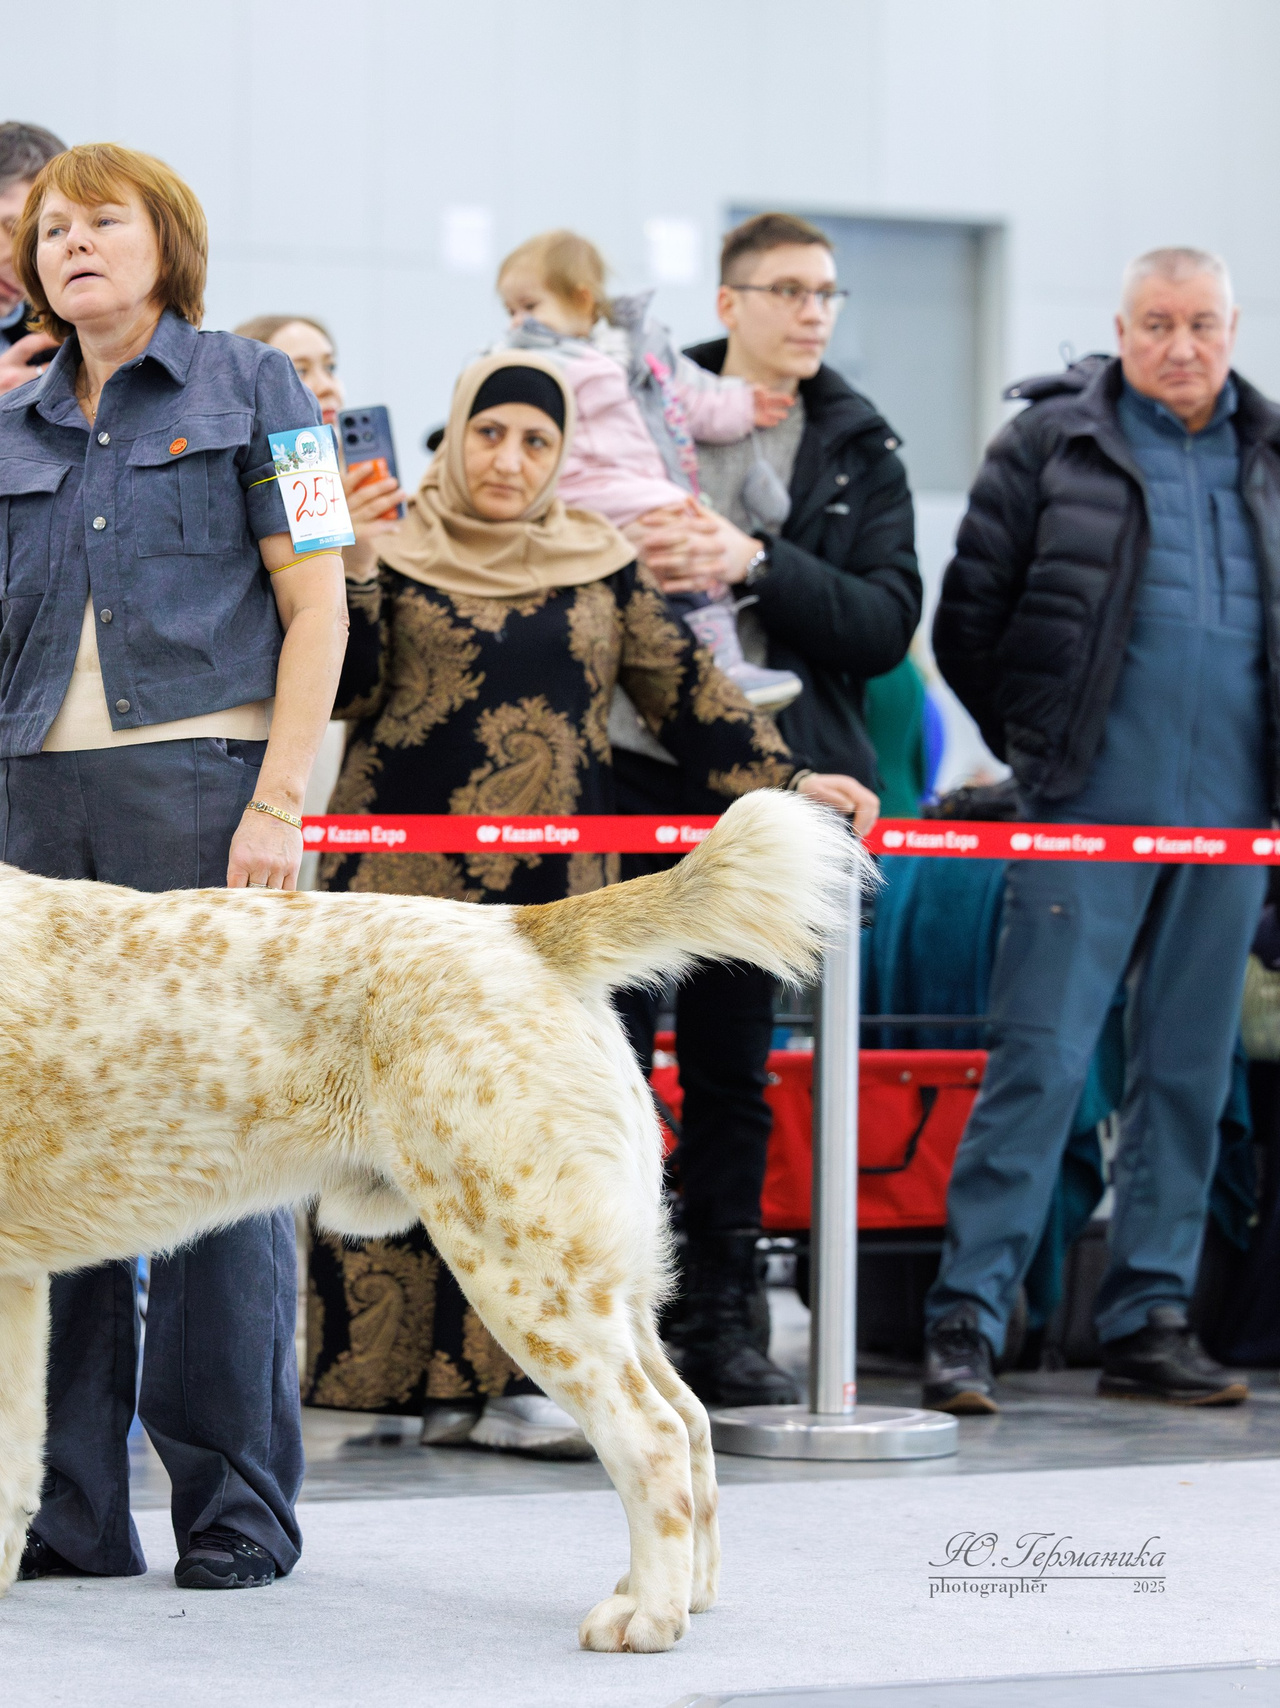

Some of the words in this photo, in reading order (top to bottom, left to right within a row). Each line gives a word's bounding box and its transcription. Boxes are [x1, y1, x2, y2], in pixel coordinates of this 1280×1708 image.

[327, 825, 370, 843] Kazan
[371, 825, 407, 847] Expo
[501, 825, 544, 843] Kazan
[544, 824, 580, 846] Expo
[905, 830, 945, 848] Kazan
[945, 830, 980, 853] Expo
[1033, 833, 1071, 852] Kazan
[1071, 833, 1107, 855] Expo
[1155, 836, 1192, 854] Kazan
[1193, 835, 1227, 858] Expo
